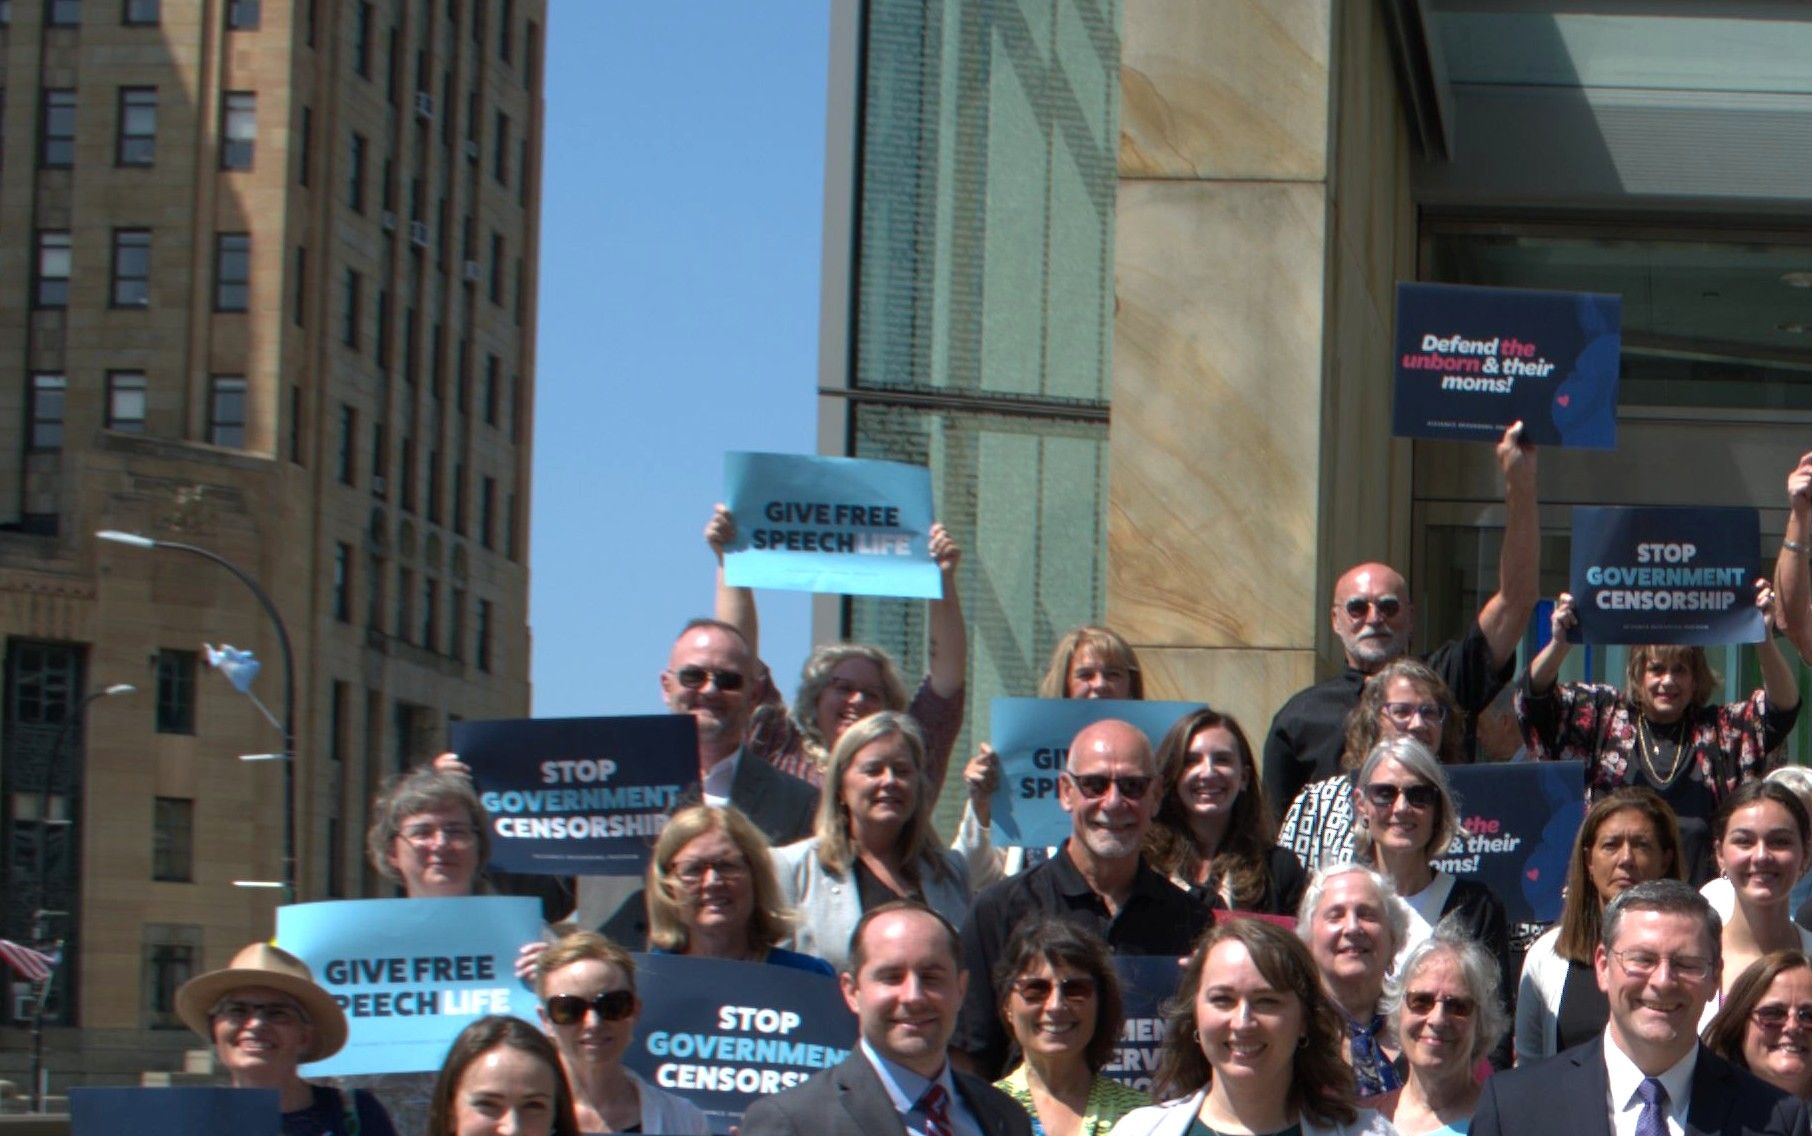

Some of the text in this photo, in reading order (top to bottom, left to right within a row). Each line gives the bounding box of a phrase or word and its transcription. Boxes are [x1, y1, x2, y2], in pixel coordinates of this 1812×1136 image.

[1422, 334, 1536, 357] Defend the
[1402, 353, 1555, 377] unborn & their
[1442, 375, 1514, 393] moms!
[766, 502, 899, 527] GIVE FREE
[753, 530, 912, 556] SPEECH LIFE
[1637, 544, 1696, 563] STOP
[1586, 566, 1745, 587] GOVERNMENT
[1596, 591, 1736, 610] CENSORSHIP
[541, 760, 617, 784] STOP
[481, 785, 681, 813] GOVERNMENT
[1464, 816, 1499, 834] the
[1448, 833, 1520, 854] & their
[1429, 856, 1480, 873] oms!
[325, 955, 495, 985] GIVE FREE
[330, 988, 511, 1017] PEECH LIFE
[719, 1005, 800, 1034] STOP
[657, 1063, 810, 1094] CENSORS
